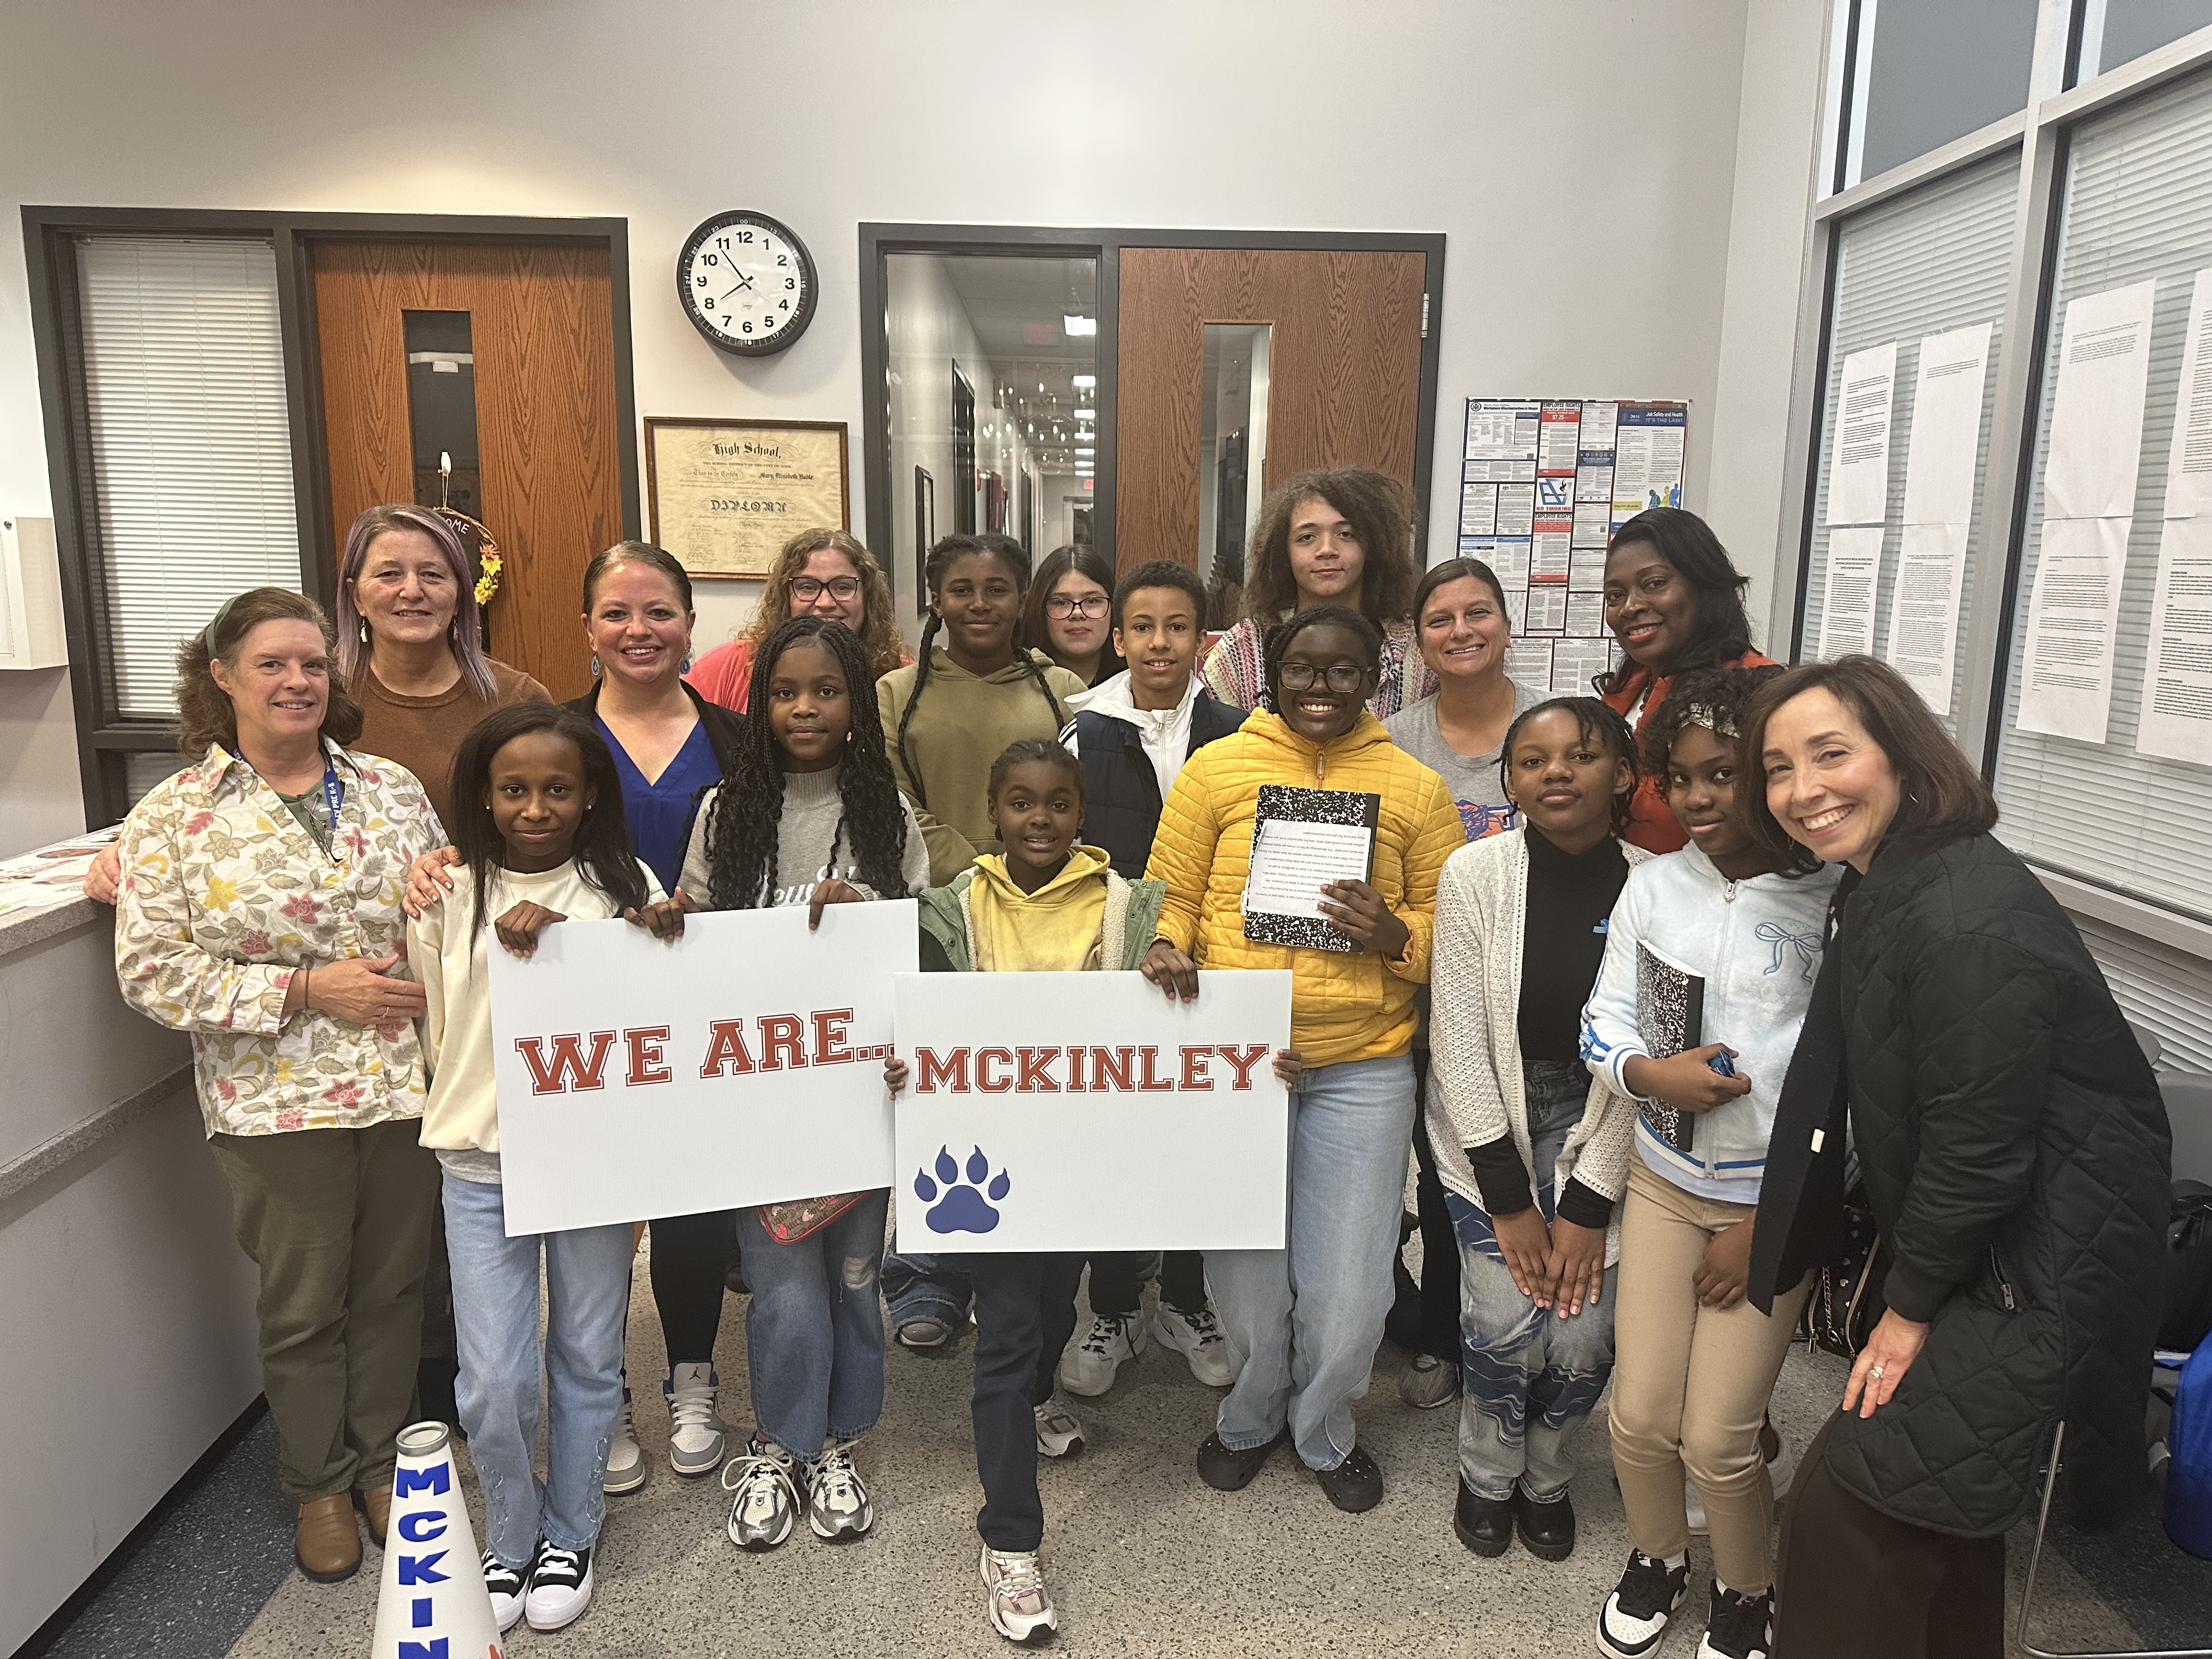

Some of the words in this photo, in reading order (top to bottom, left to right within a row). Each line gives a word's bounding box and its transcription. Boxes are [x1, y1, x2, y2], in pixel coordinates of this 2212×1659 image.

[736, 231, 753, 243] 12
[715, 238, 730, 249] 11
[763, 238, 769, 250] 1
[691, 246, 698, 255] 22
[701, 254, 718, 266] 10
[777, 254, 787, 266] 2
[697, 275, 707, 287] 9
[785, 278, 795, 290] 3
[704, 297, 715, 309] 8
[778, 299, 789, 311] 4
[722, 315, 732, 327] 7
[742, 321, 753, 333] 6
[764, 316, 774, 328] 5
[713, 443, 740, 456] High
[328, 782, 337, 794] K-8
[330, 795, 340, 809] PRE
[515, 1025, 674, 1096] WE
[916, 1043, 1269, 1093] MCKINLEY
